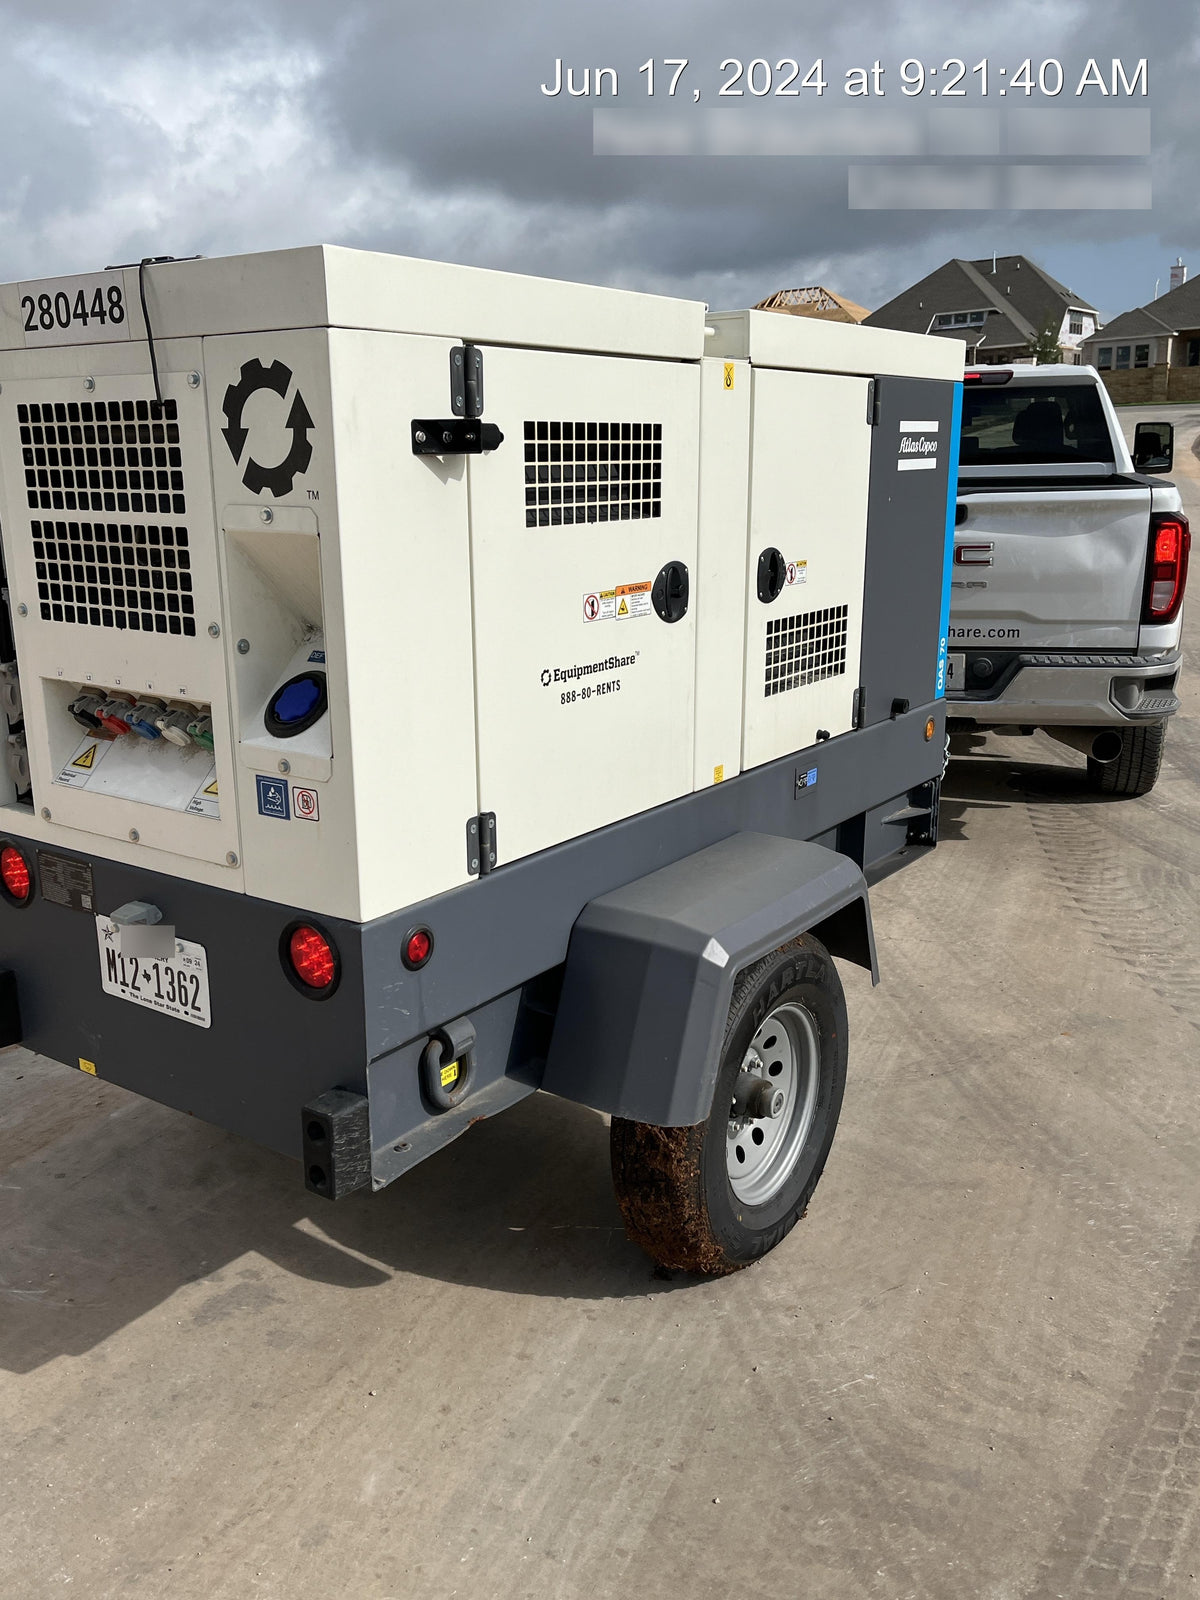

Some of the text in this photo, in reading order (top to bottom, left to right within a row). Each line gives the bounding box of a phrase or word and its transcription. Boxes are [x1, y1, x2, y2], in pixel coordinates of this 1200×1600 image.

[21, 285, 125, 332] 280448
[628, 584, 648, 593] WARNING
[553, 654, 636, 683] EquipmentShare
[560, 680, 621, 705] 888-80-RENTS
[105, 947, 202, 1013] M12 1362
[129, 991, 181, 1014] The Lone Star State
